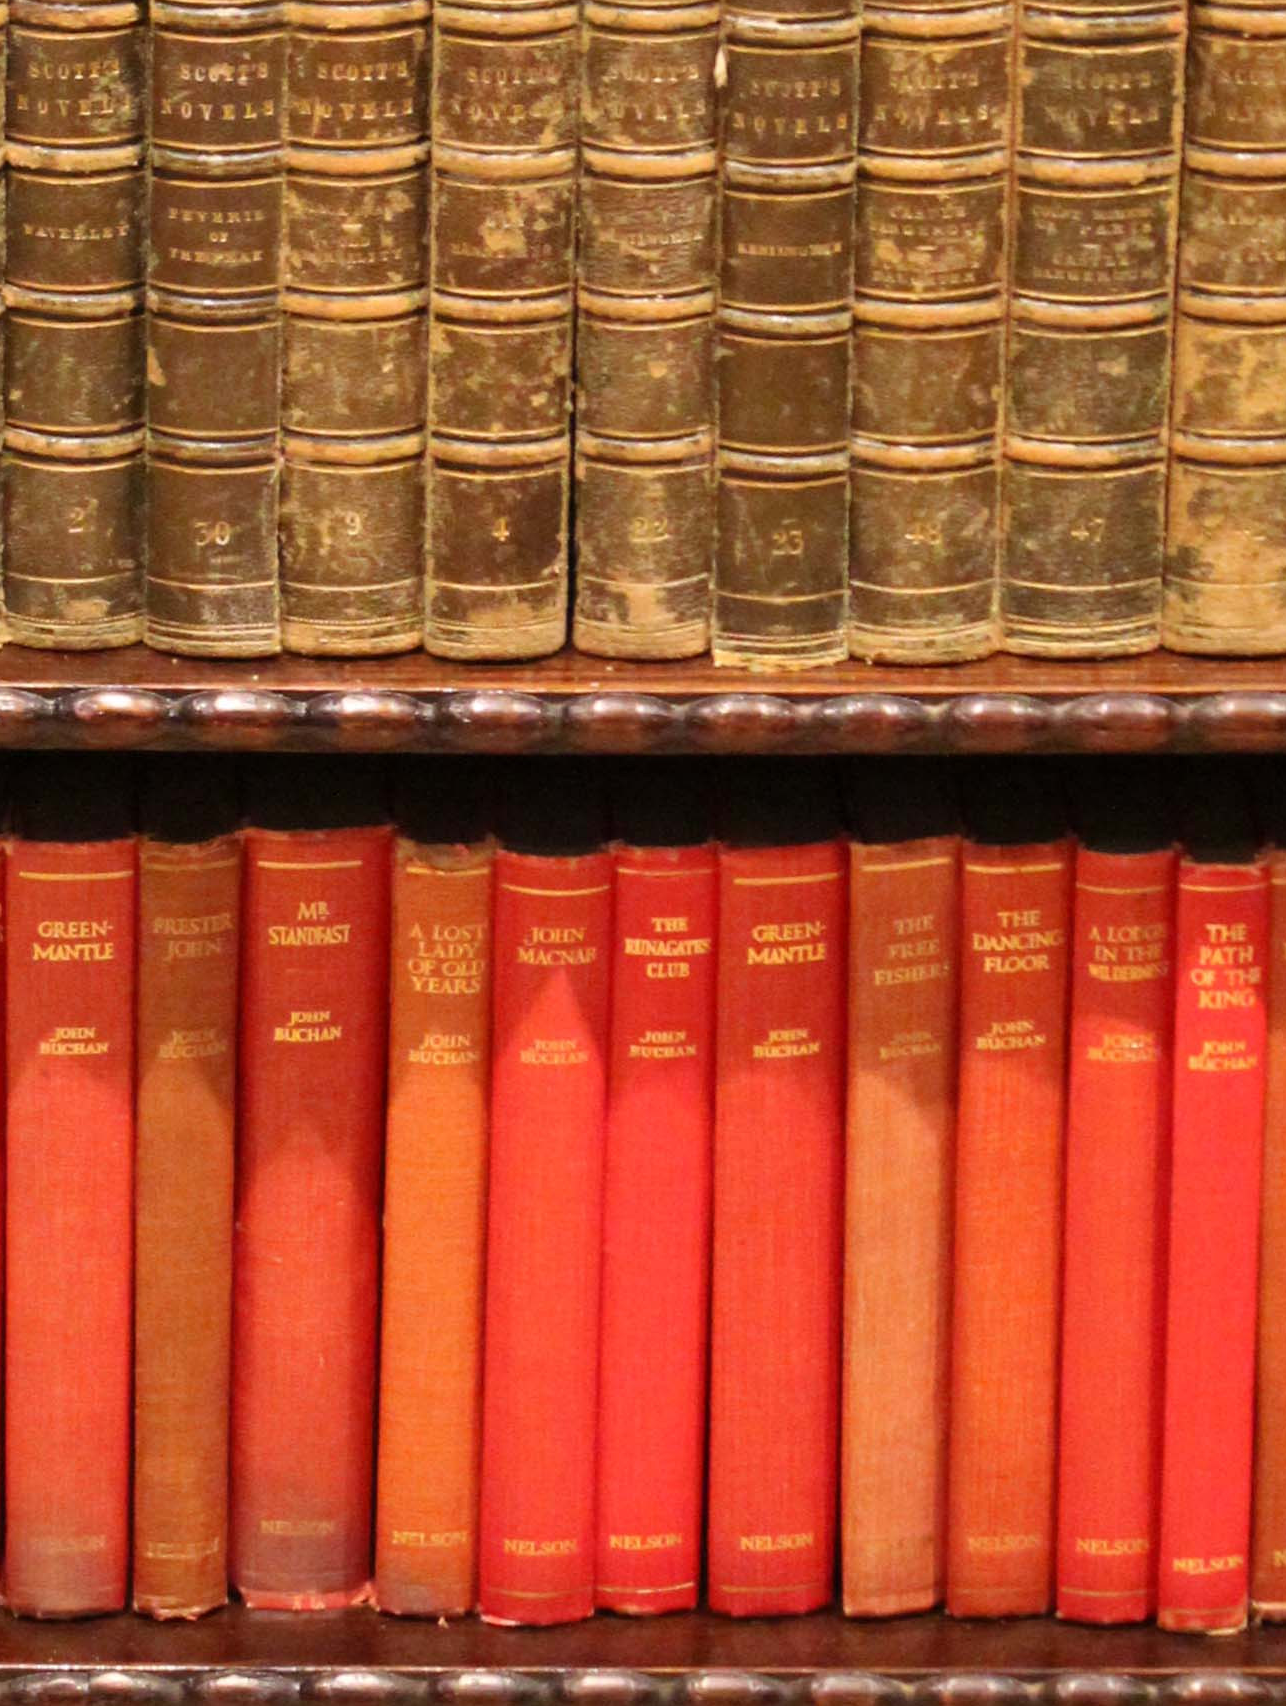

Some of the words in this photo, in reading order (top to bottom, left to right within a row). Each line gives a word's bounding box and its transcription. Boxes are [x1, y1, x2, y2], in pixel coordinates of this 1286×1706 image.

[33, 944, 113, 961] MANTLE
[647, 963, 690, 979] CLUB
[51, 1027, 96, 1041] JOHN
[274, 1027, 341, 1042] BUCHAN
